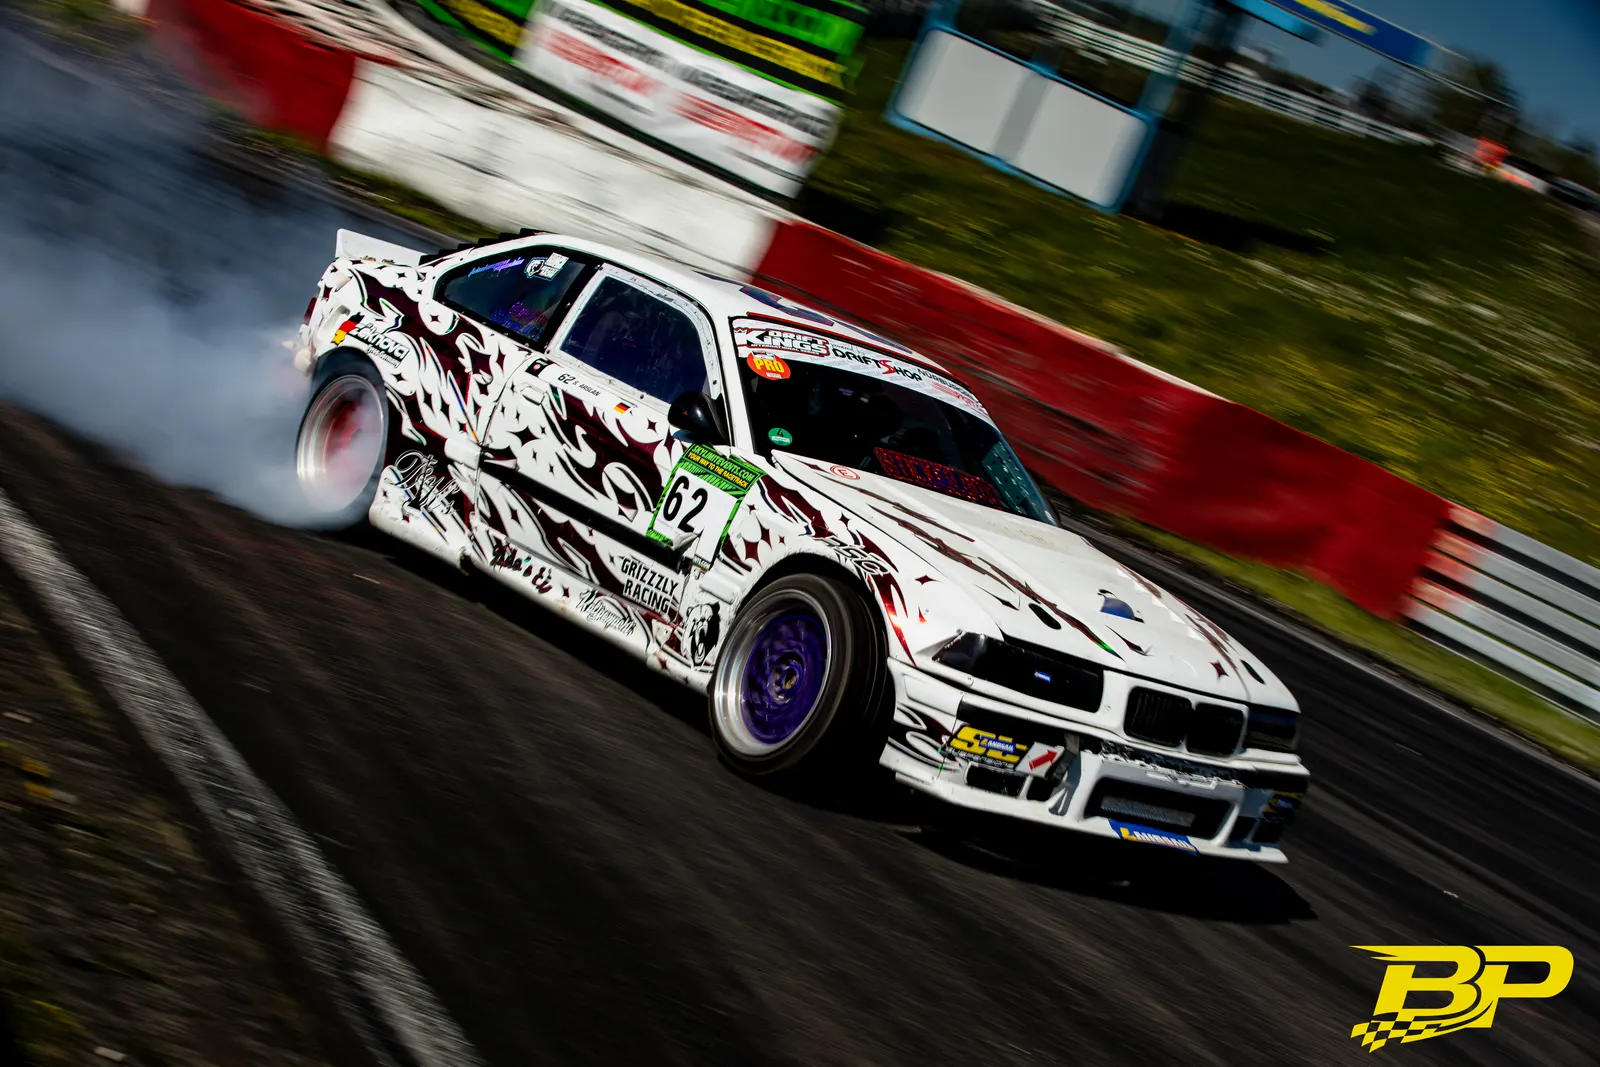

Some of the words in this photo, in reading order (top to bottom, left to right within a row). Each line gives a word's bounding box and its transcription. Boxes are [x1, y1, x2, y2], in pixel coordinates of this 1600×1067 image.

[768, 330, 827, 345] DRIFT
[753, 358, 785, 373] PRO
[832, 348, 922, 381] DRIFTSHOP
[557, 373, 576, 385] 62
[579, 384, 601, 397] ARSLAN
[776, 428, 784, 437] 4
[687, 451, 700, 463] YOUR
[699, 457, 710, 467] WAY
[707, 462, 715, 471] TO
[713, 465, 724, 475] THE
[721, 469, 749, 488] RACETRACK
[691, 445, 755, 482] SKYLIMITEVENTS.COM
[662, 475, 709, 533] 62
[620, 556, 679, 597] GRIZZZLY
[622, 580, 671, 615] RACING
